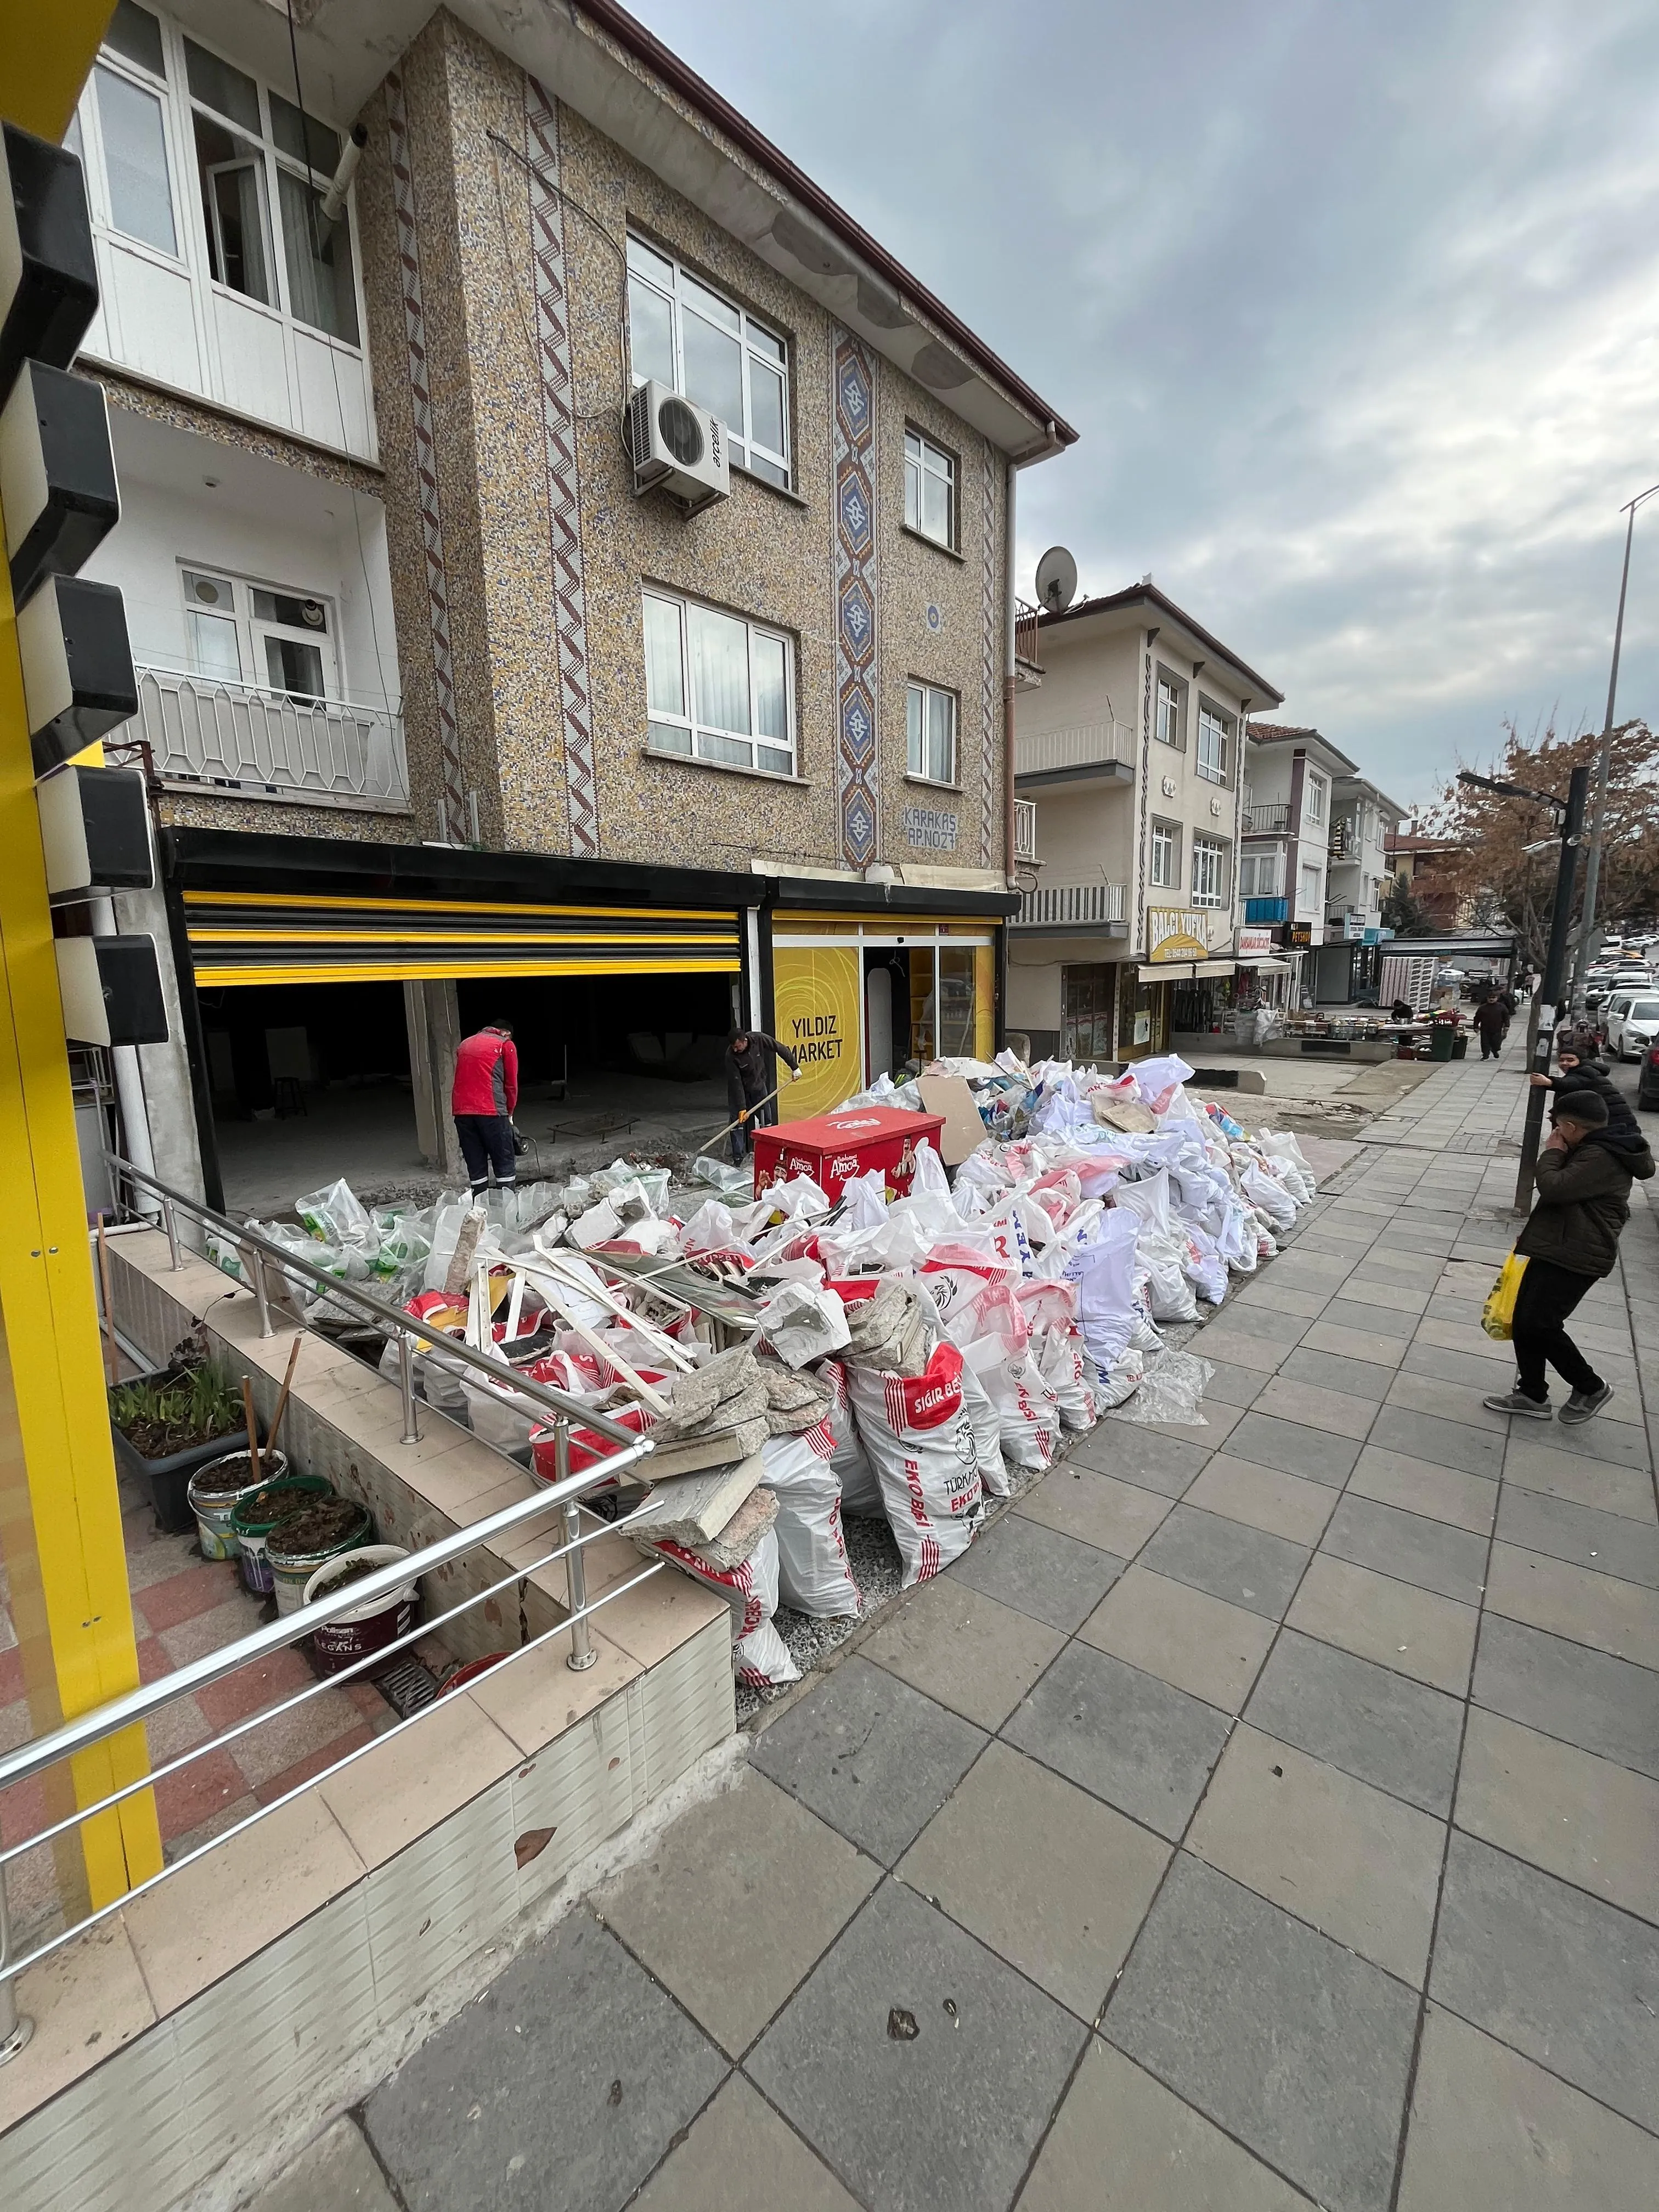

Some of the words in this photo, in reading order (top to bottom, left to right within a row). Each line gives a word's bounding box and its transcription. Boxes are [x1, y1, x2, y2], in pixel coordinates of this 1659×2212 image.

[709, 417, 721, 468] arçelik
[905, 806, 956, 832] KARAKAS
[1152, 911, 1178, 953] BALCI
[1180, 912, 1207, 952] YUFKA
[792, 1015, 837, 1038] YILDIZ
[789, 1158, 813, 1171] Amca
[830, 1159, 858, 1179] Amca
[904, 1459, 923, 1497] EKO
